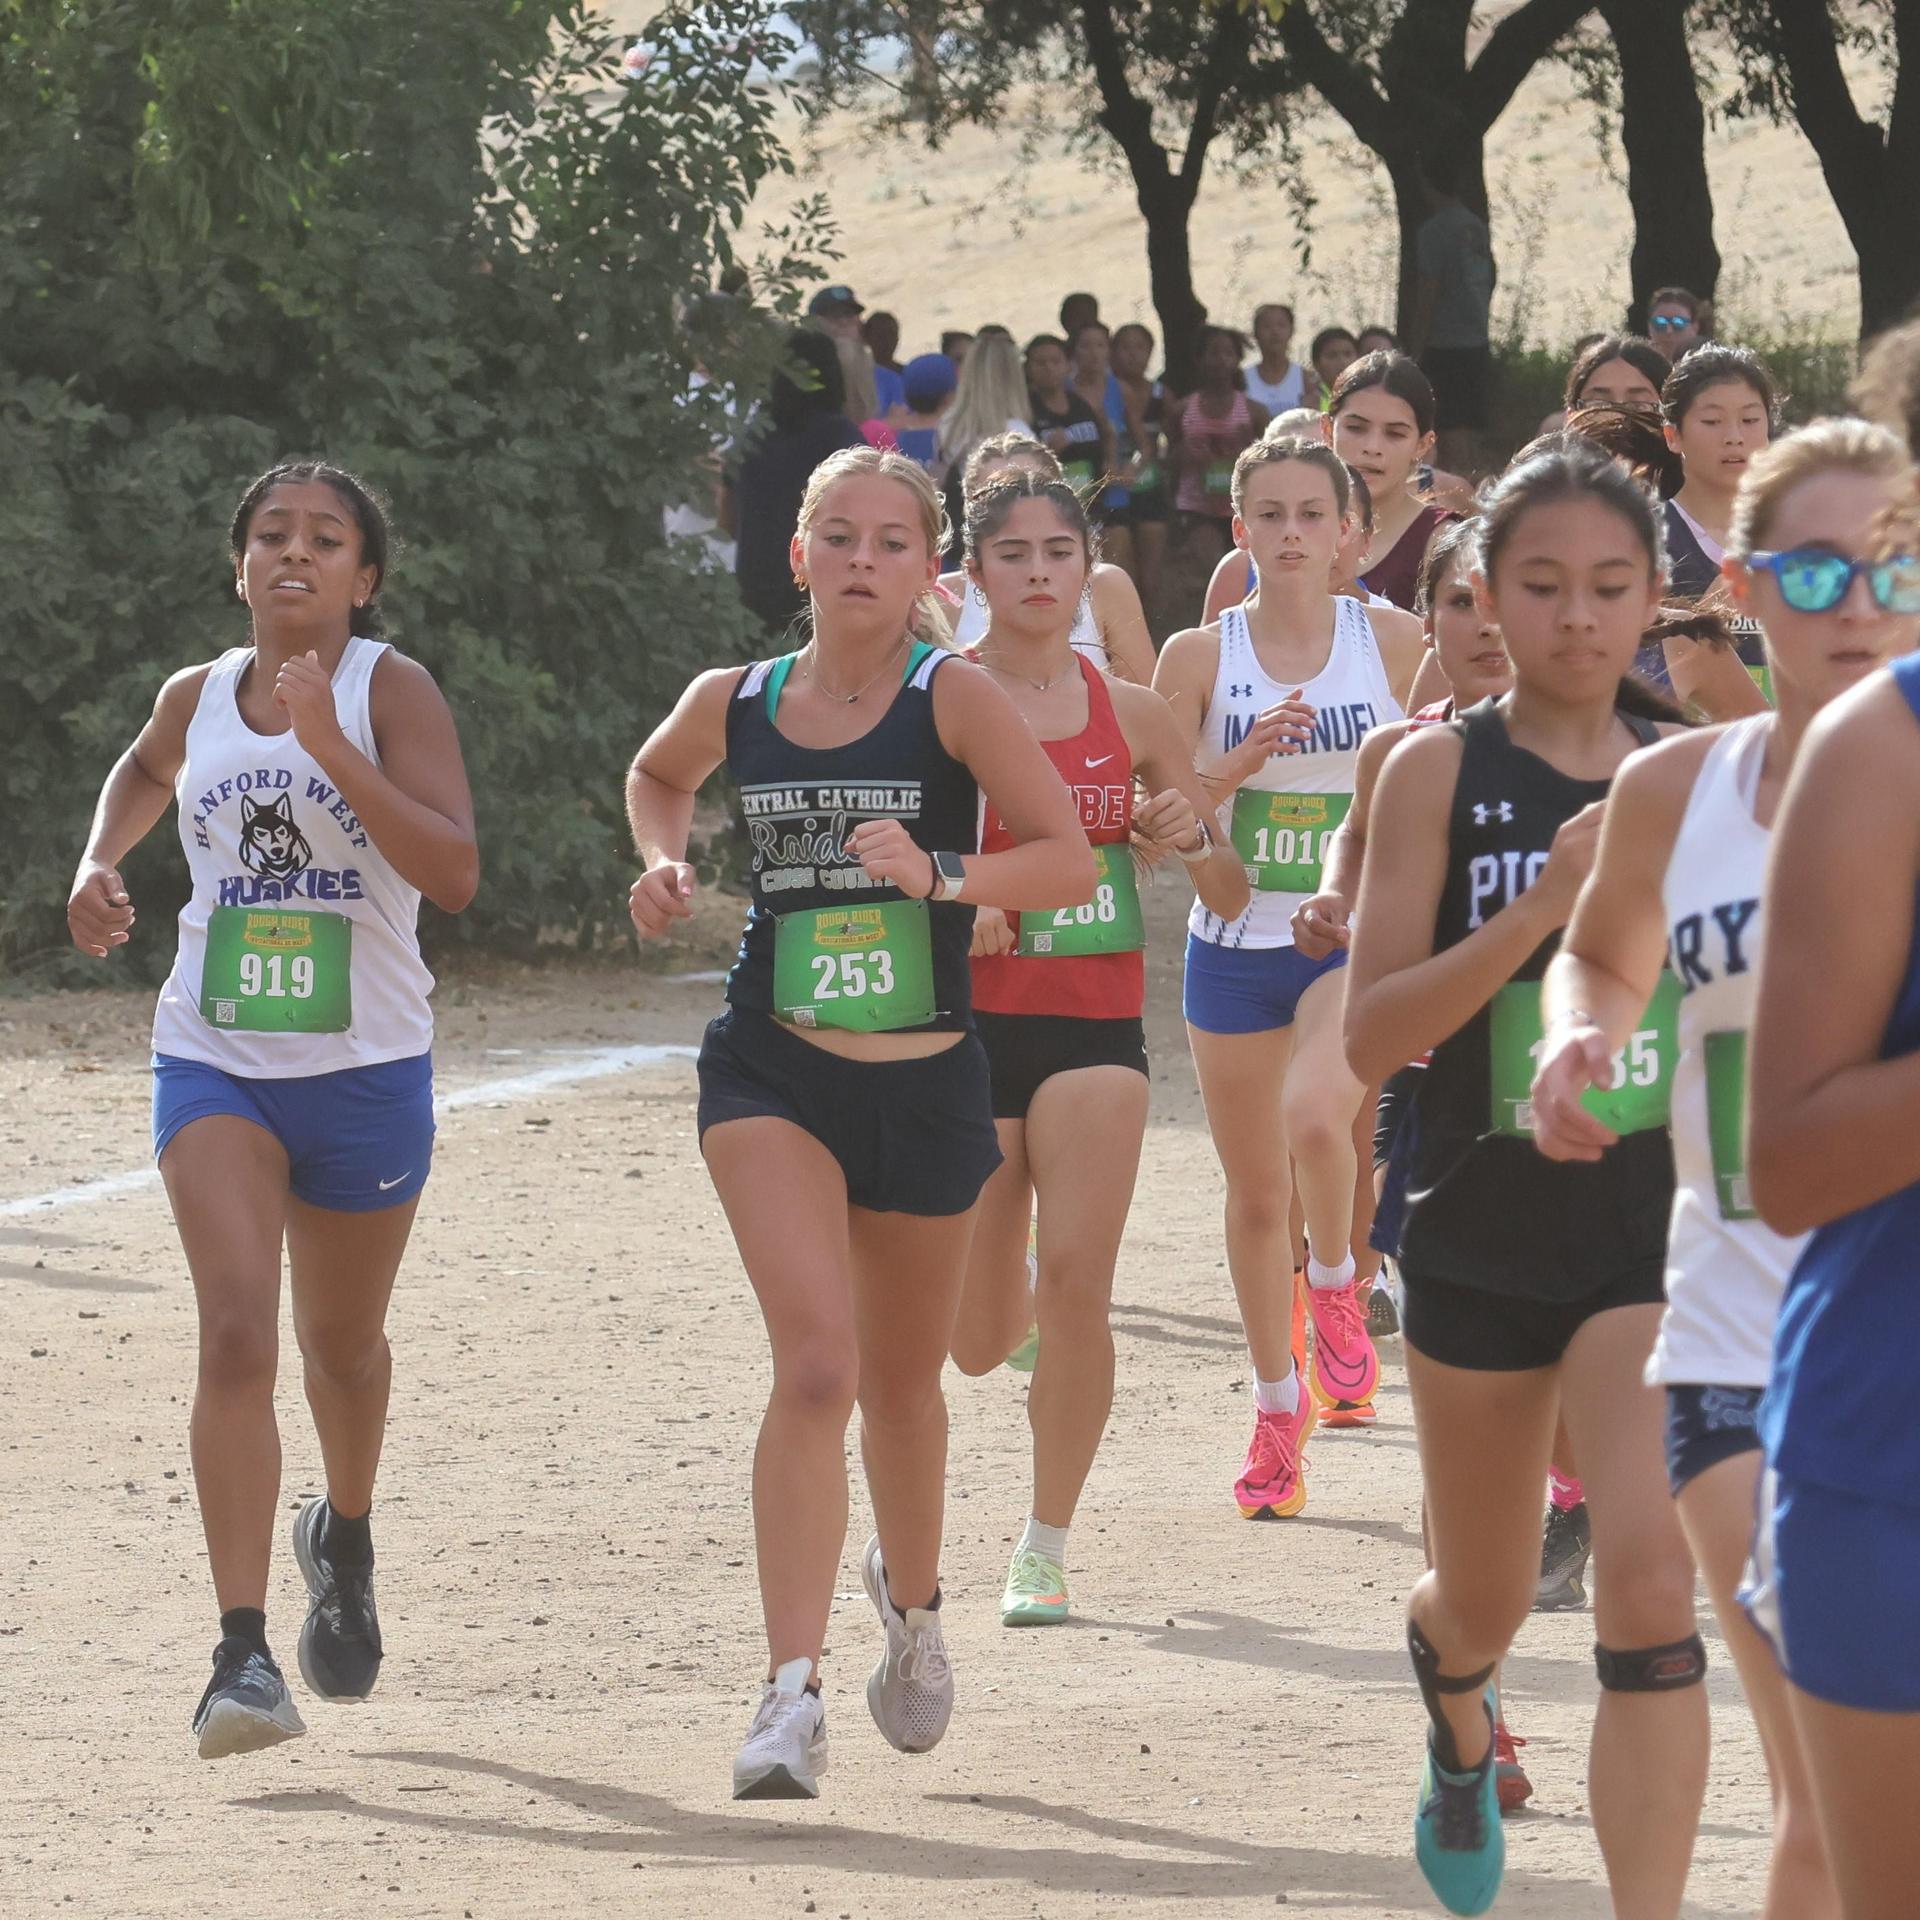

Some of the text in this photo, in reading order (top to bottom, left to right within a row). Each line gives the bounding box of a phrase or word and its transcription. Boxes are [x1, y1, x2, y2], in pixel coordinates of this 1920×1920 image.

[193, 769, 368, 850] HANFORD WEST
[742, 788, 922, 815] ENTRAL CATHOLIC
[218, 868, 365, 908] HUSKIES
[760, 866, 816, 894] CROSS
[239, 953, 314, 999] 919
[811, 949, 895, 1000] 253
